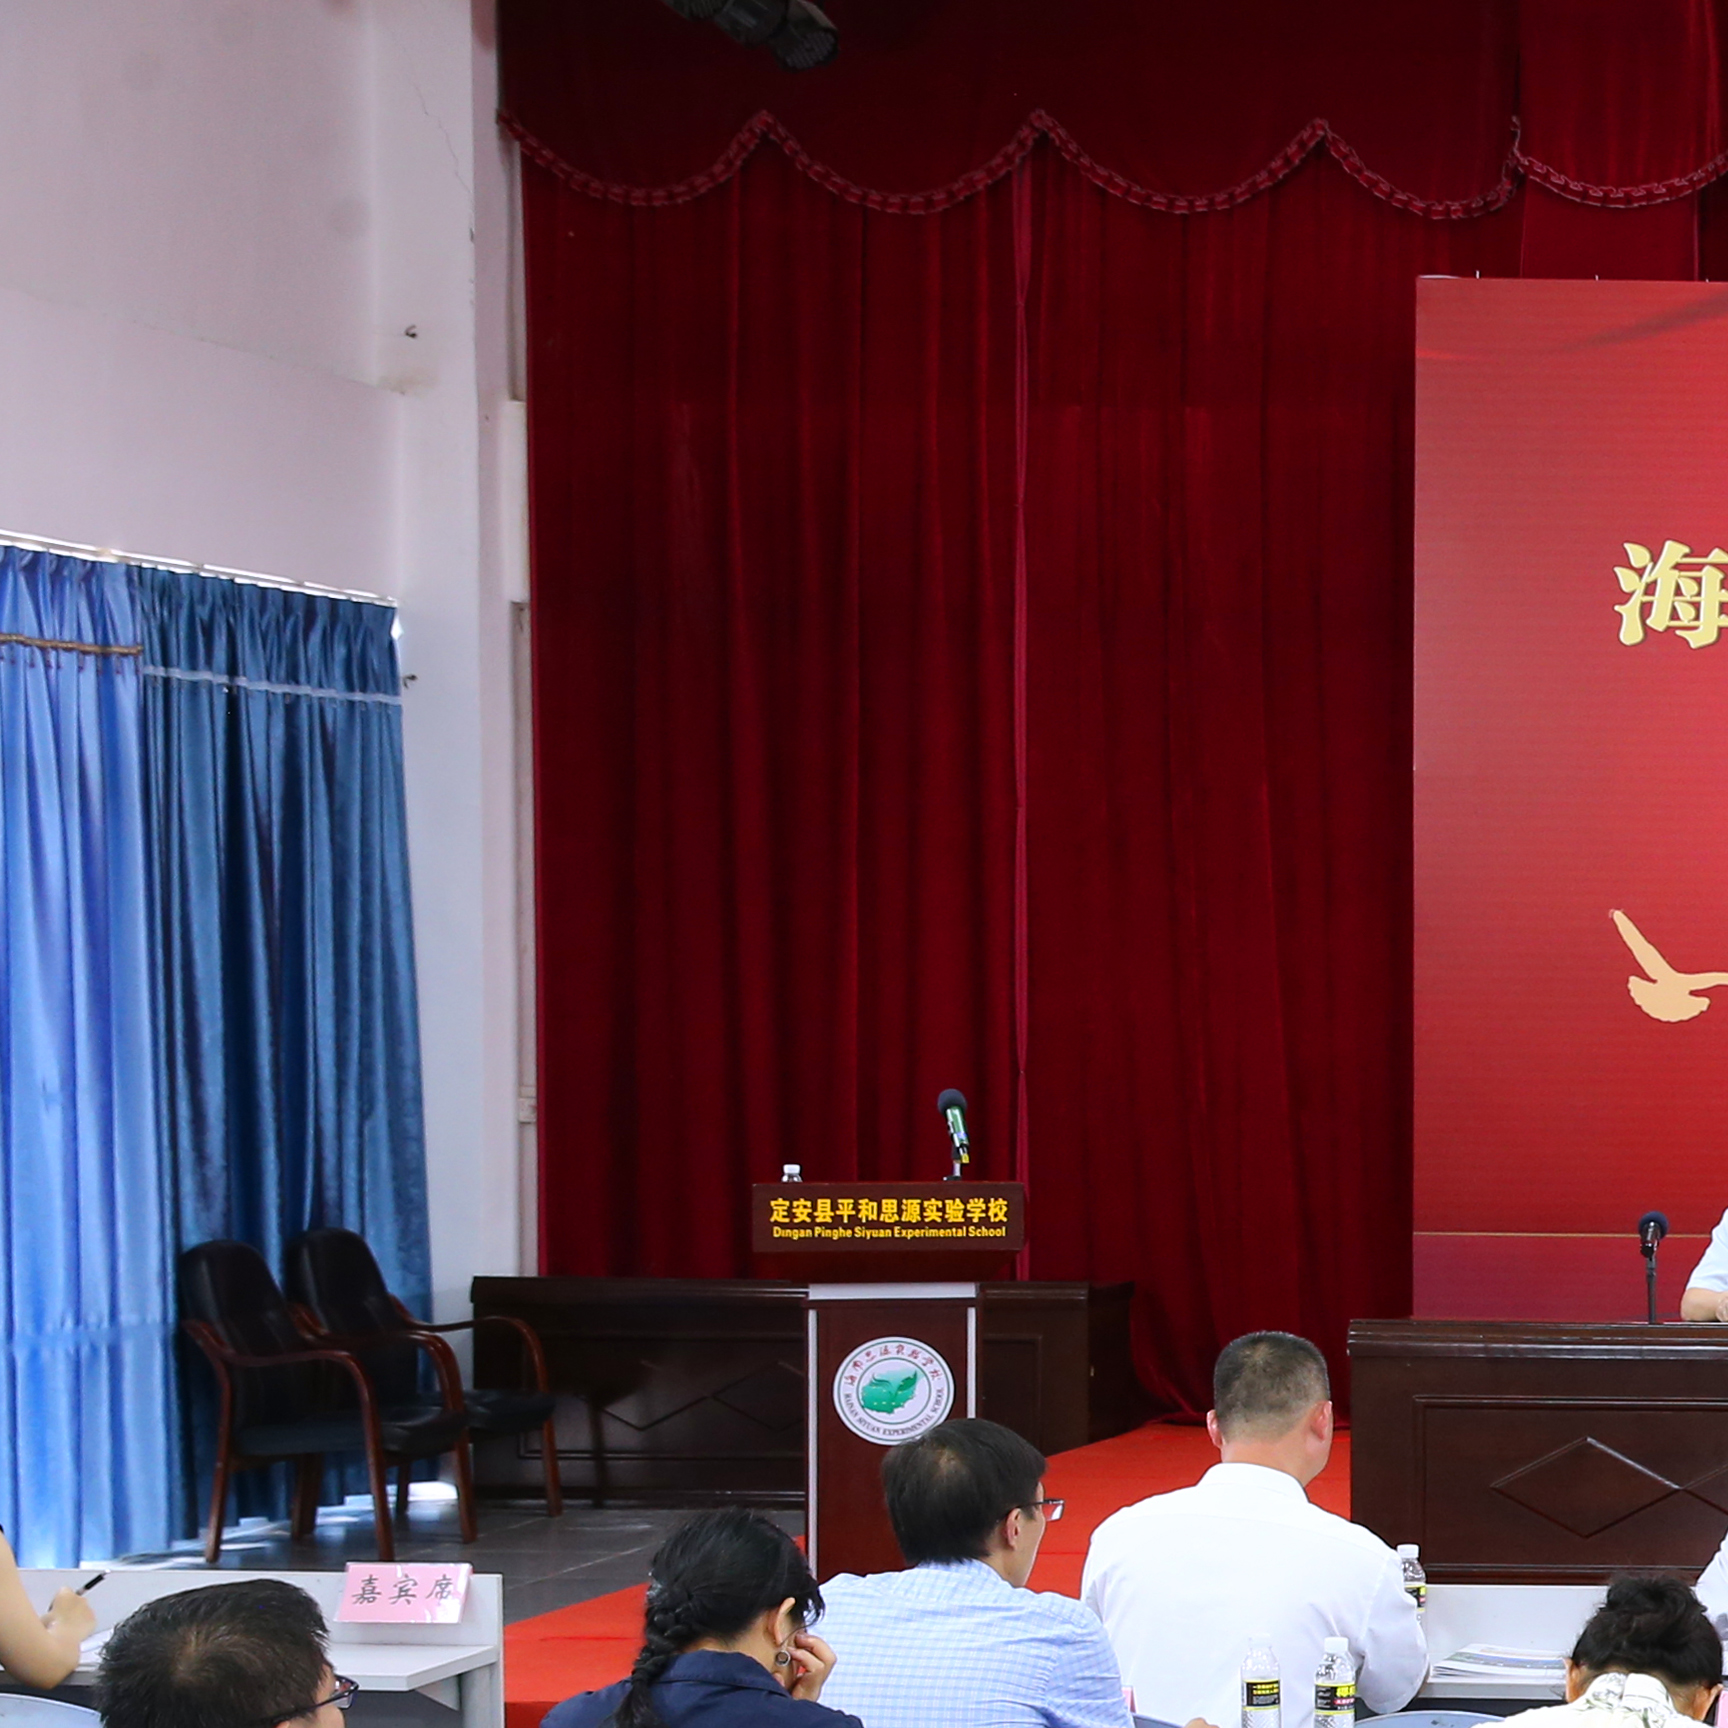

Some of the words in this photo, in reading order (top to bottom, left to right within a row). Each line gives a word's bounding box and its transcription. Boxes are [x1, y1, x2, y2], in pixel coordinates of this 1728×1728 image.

[769, 1197, 1008, 1224] 定安县平和思源实验学校
[773, 1226, 812, 1240] Dingan
[814, 1226, 852, 1240] Pinghe
[854, 1226, 892, 1240] Siyuan
[894, 1226, 966, 1240] Experimental
[968, 1226, 1006, 1238] School
[351, 1572, 454, 1606] 嘉宾席
